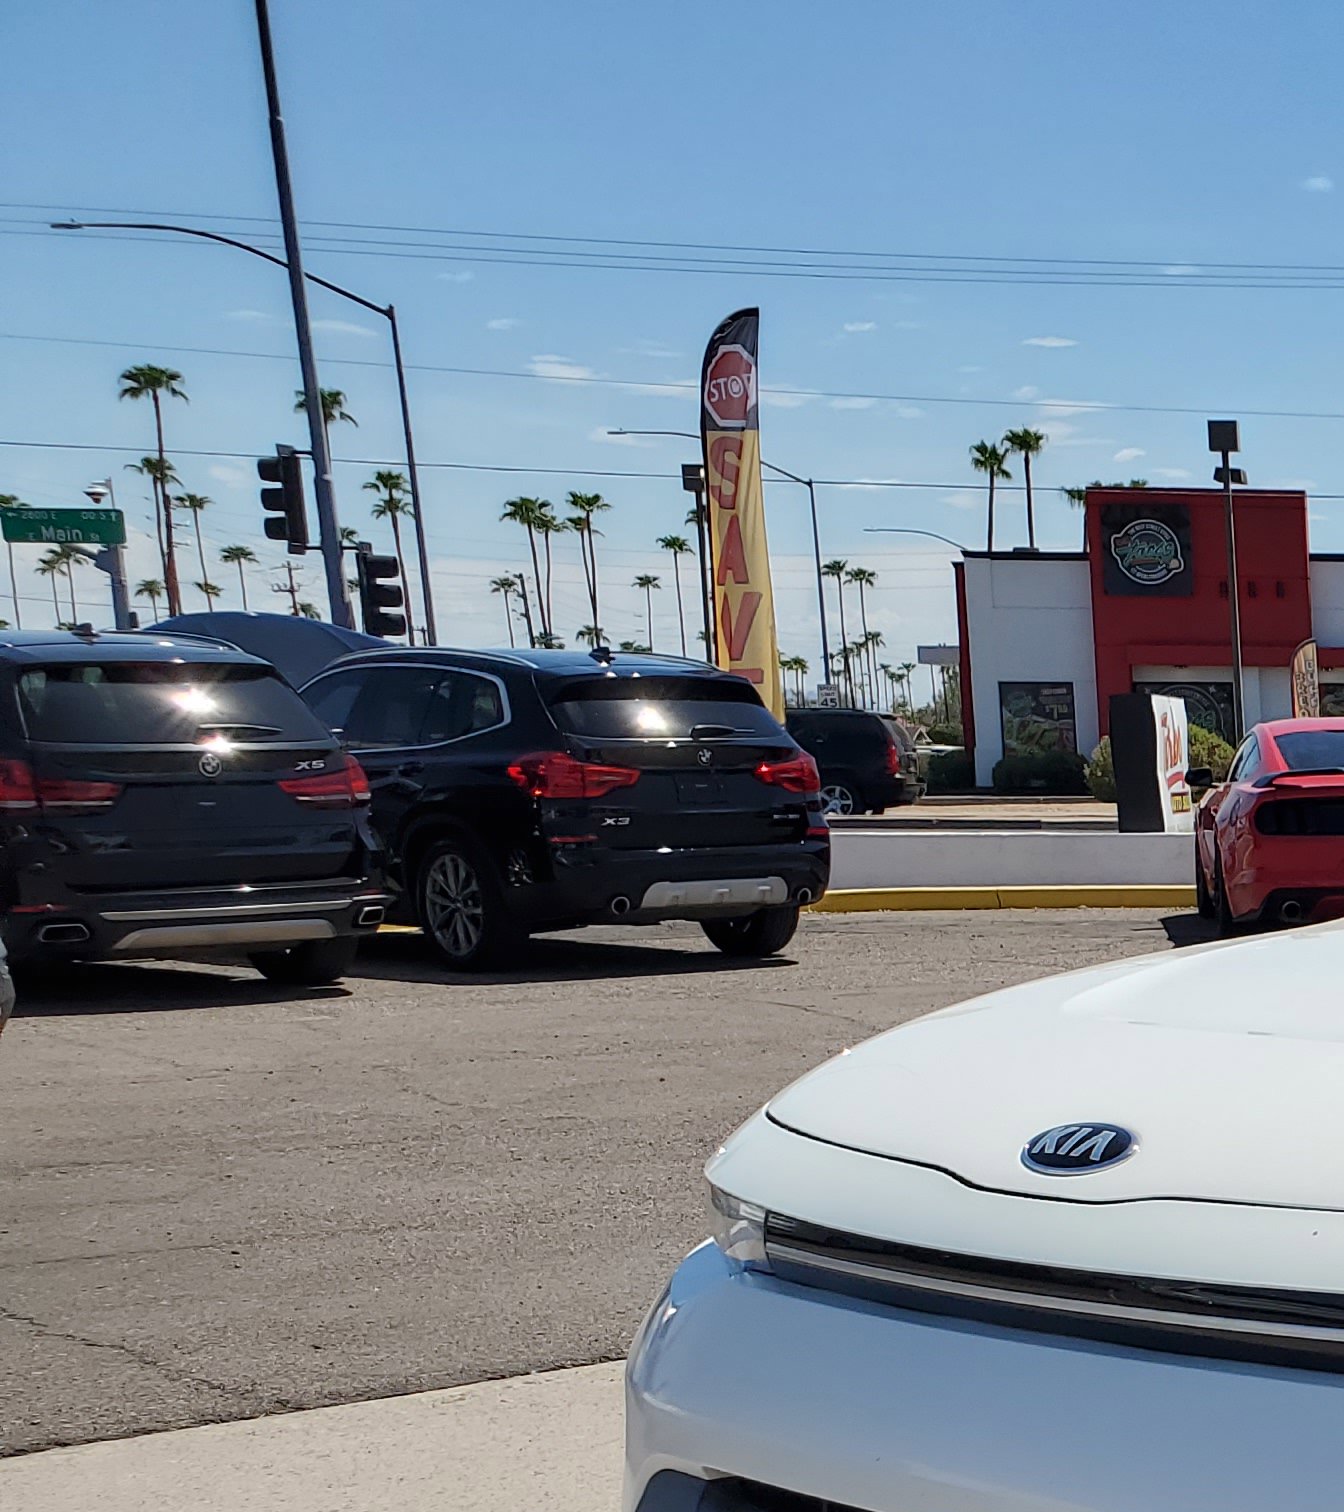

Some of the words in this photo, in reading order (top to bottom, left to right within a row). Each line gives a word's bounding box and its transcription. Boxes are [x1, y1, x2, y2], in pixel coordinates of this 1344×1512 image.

[40, 525, 83, 541] Main
[709, 436, 765, 684] SAV
[820, 697, 838, 708] 45
[294, 759, 326, 772] X5
[600, 816, 631, 827] X3
[1030, 1126, 1117, 1162] KIA
